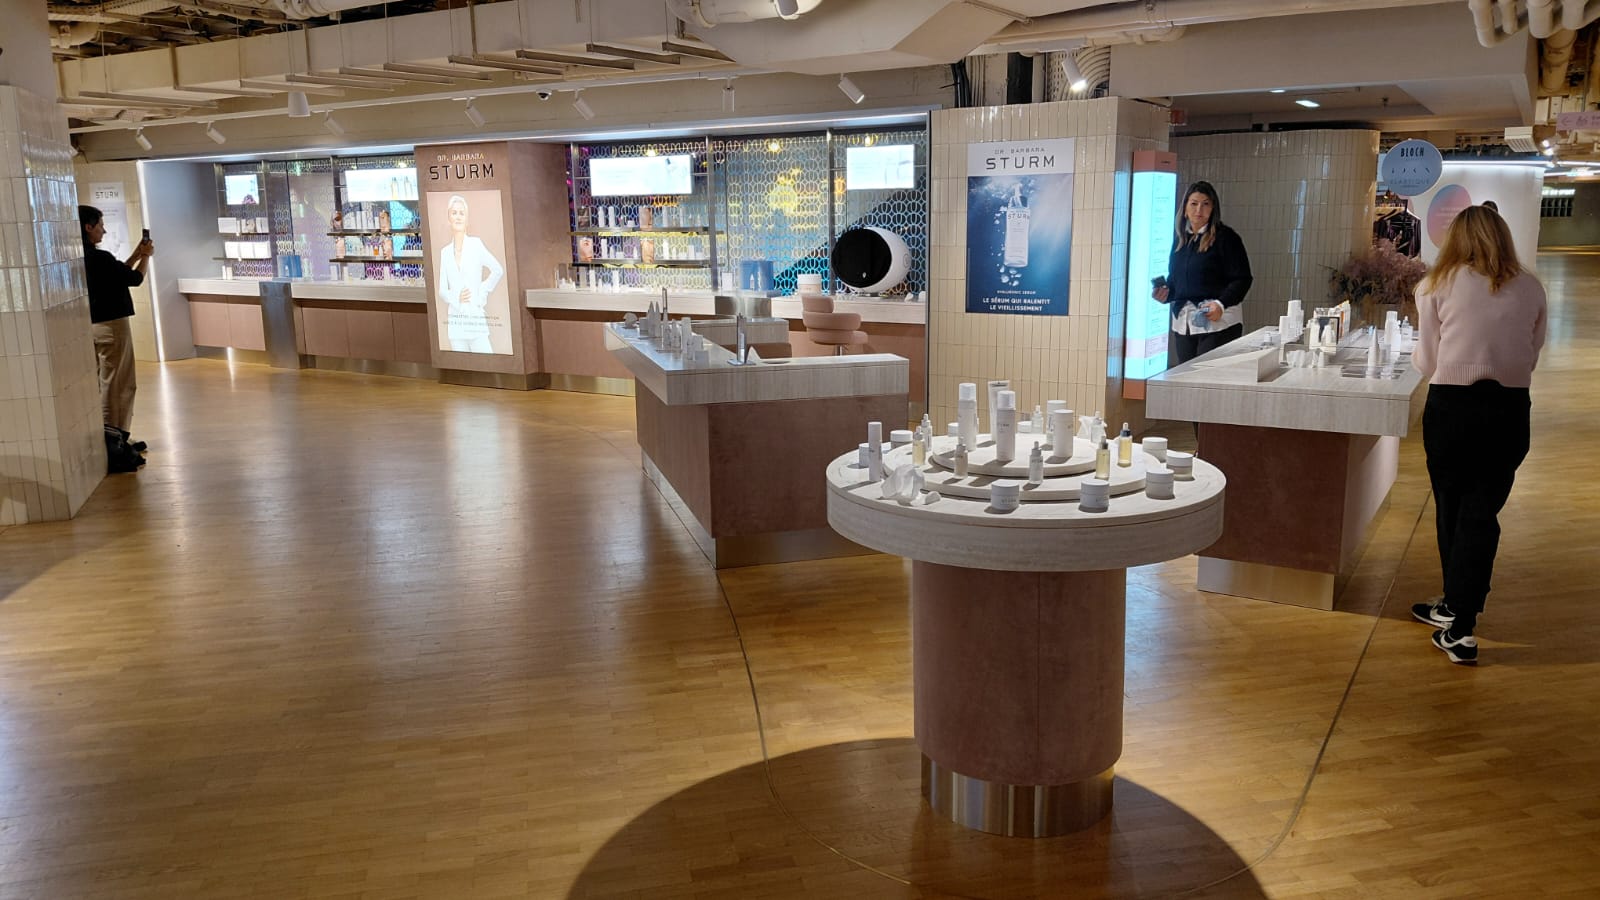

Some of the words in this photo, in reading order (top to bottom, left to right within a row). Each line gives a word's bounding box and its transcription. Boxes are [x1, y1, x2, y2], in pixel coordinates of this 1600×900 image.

[452, 152, 484, 161] BARBARA
[1400, 147, 1425, 157] BLOCH
[985, 155, 1055, 170] STURM
[429, 162, 494, 180] STURM
[95, 191, 119, 199] STURM
[990, 296, 1009, 304] SÉRUM
